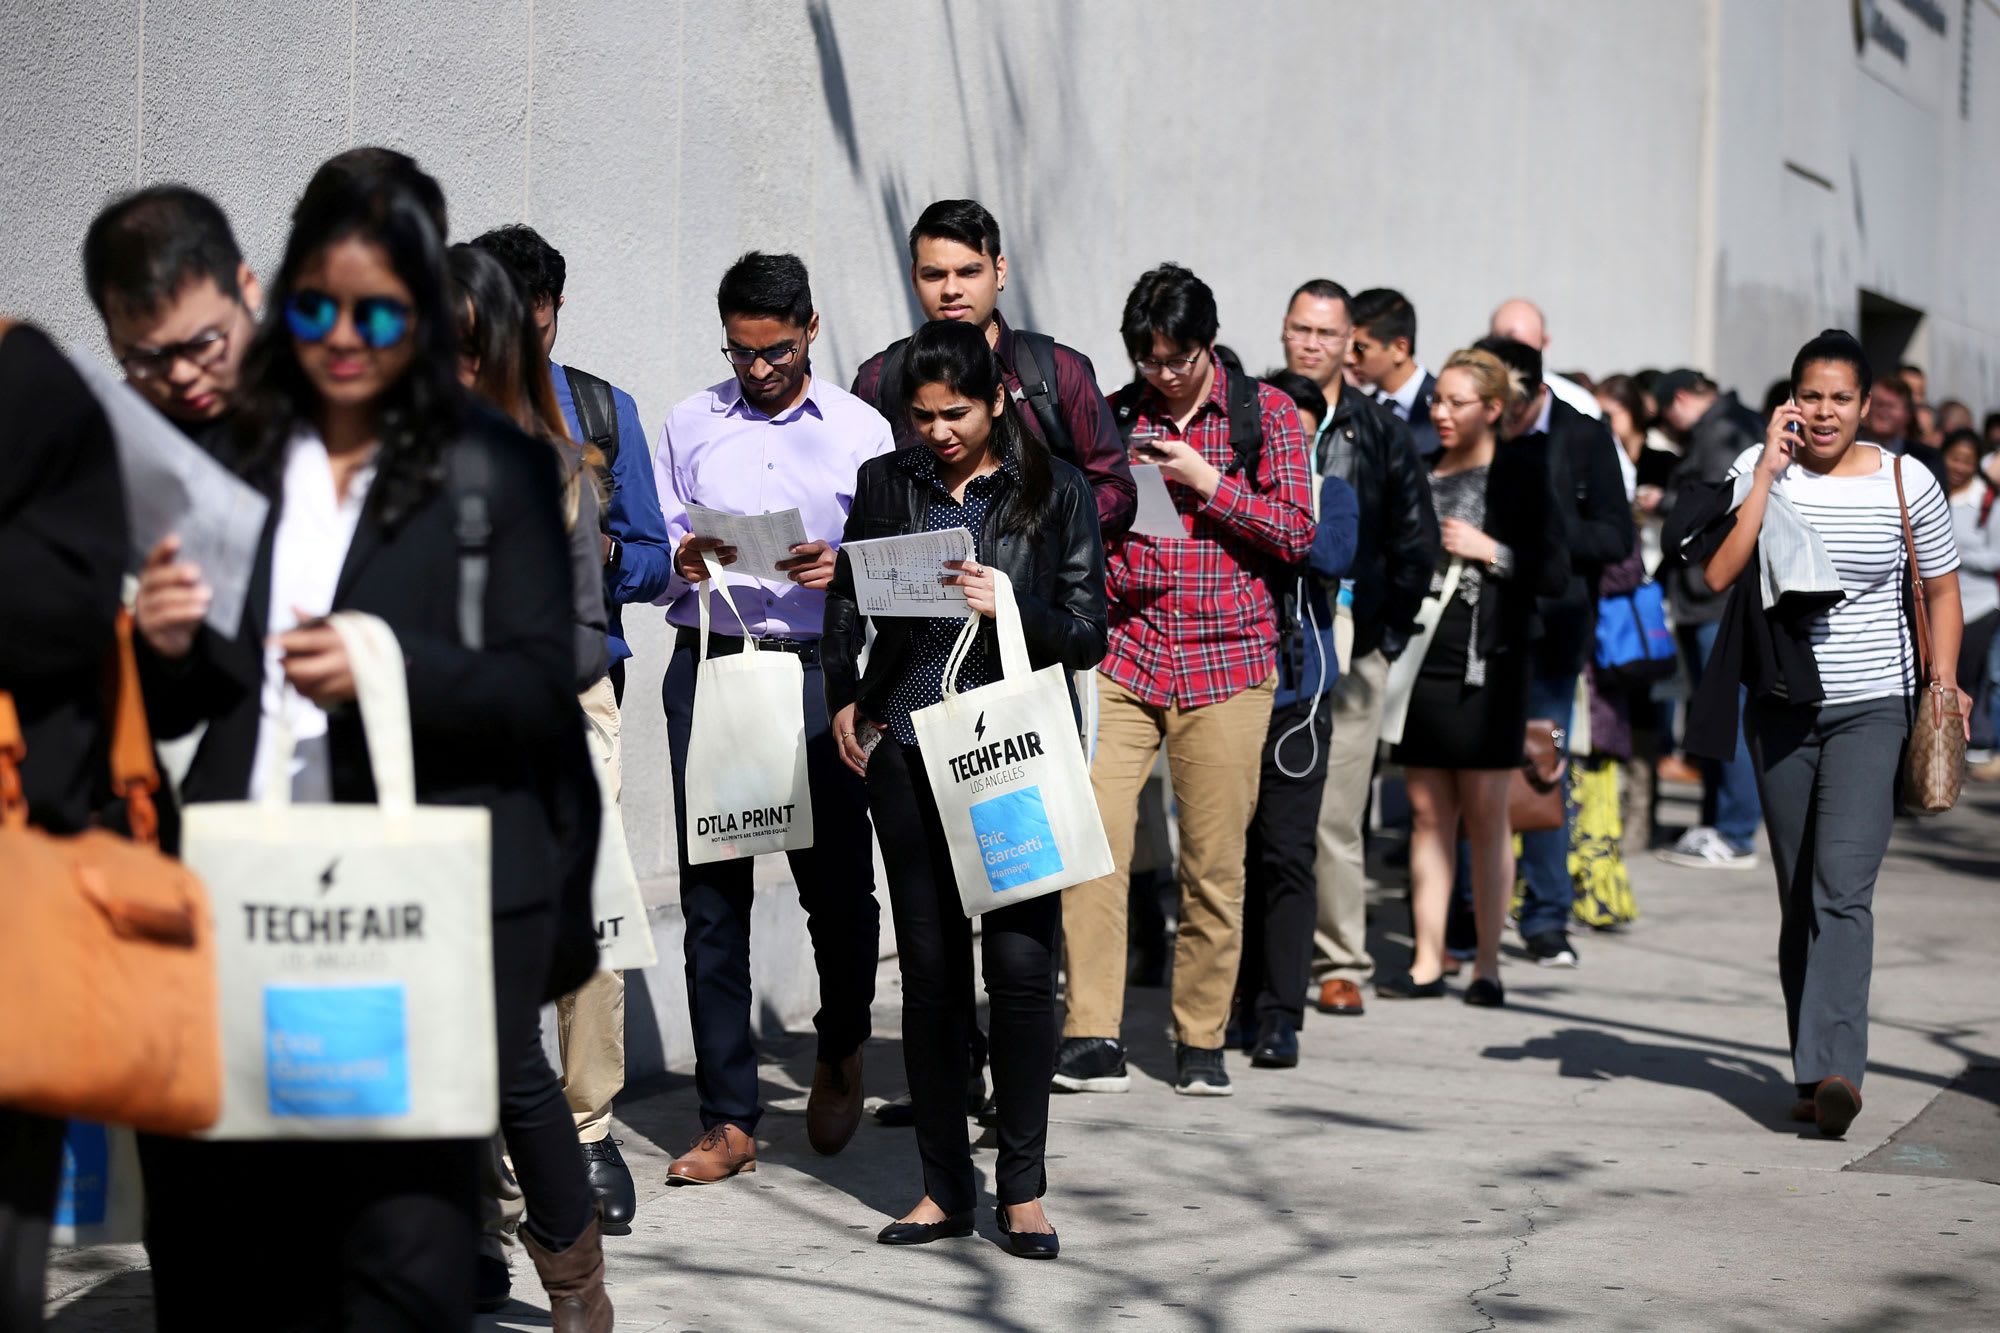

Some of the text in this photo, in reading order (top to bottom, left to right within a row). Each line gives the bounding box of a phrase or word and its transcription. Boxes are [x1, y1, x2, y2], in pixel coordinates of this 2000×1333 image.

[949, 731, 1045, 783] TECHFAIR
[970, 765, 1025, 794] LOS ANGELES
[697, 804, 795, 836] DTLA PRINT
[979, 830, 1007, 848] Eric
[985, 835, 1043, 866] Garcetti
[243, 903, 425, 944] TECHFAIR
